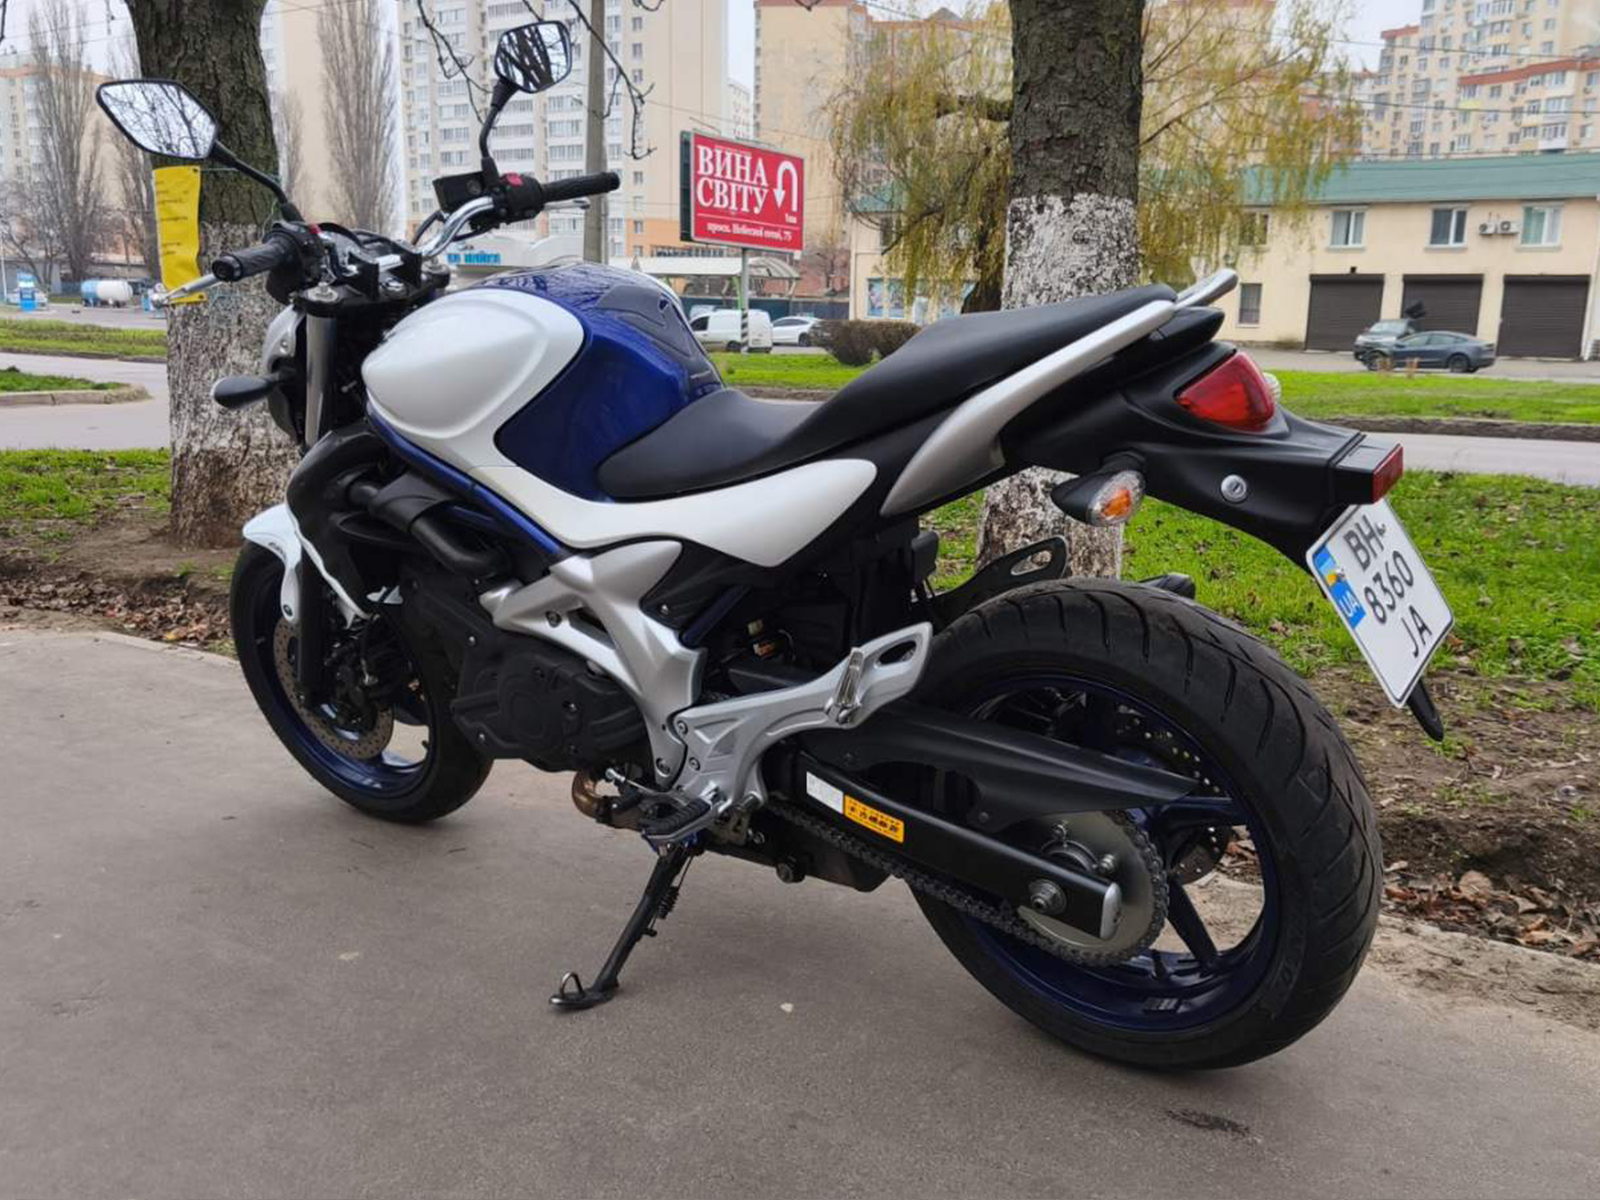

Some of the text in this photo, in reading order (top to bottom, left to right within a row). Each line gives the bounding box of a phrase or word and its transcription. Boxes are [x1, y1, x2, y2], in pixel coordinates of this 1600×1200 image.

[697, 145, 768, 187] ВИНА
[697, 177, 769, 214] СВІТУ
[1343, 514, 1387, 572] BH
[1339, 590, 1360, 617] UA
[1364, 550, 1415, 625] 8360
[1401, 604, 1433, 659] JA
